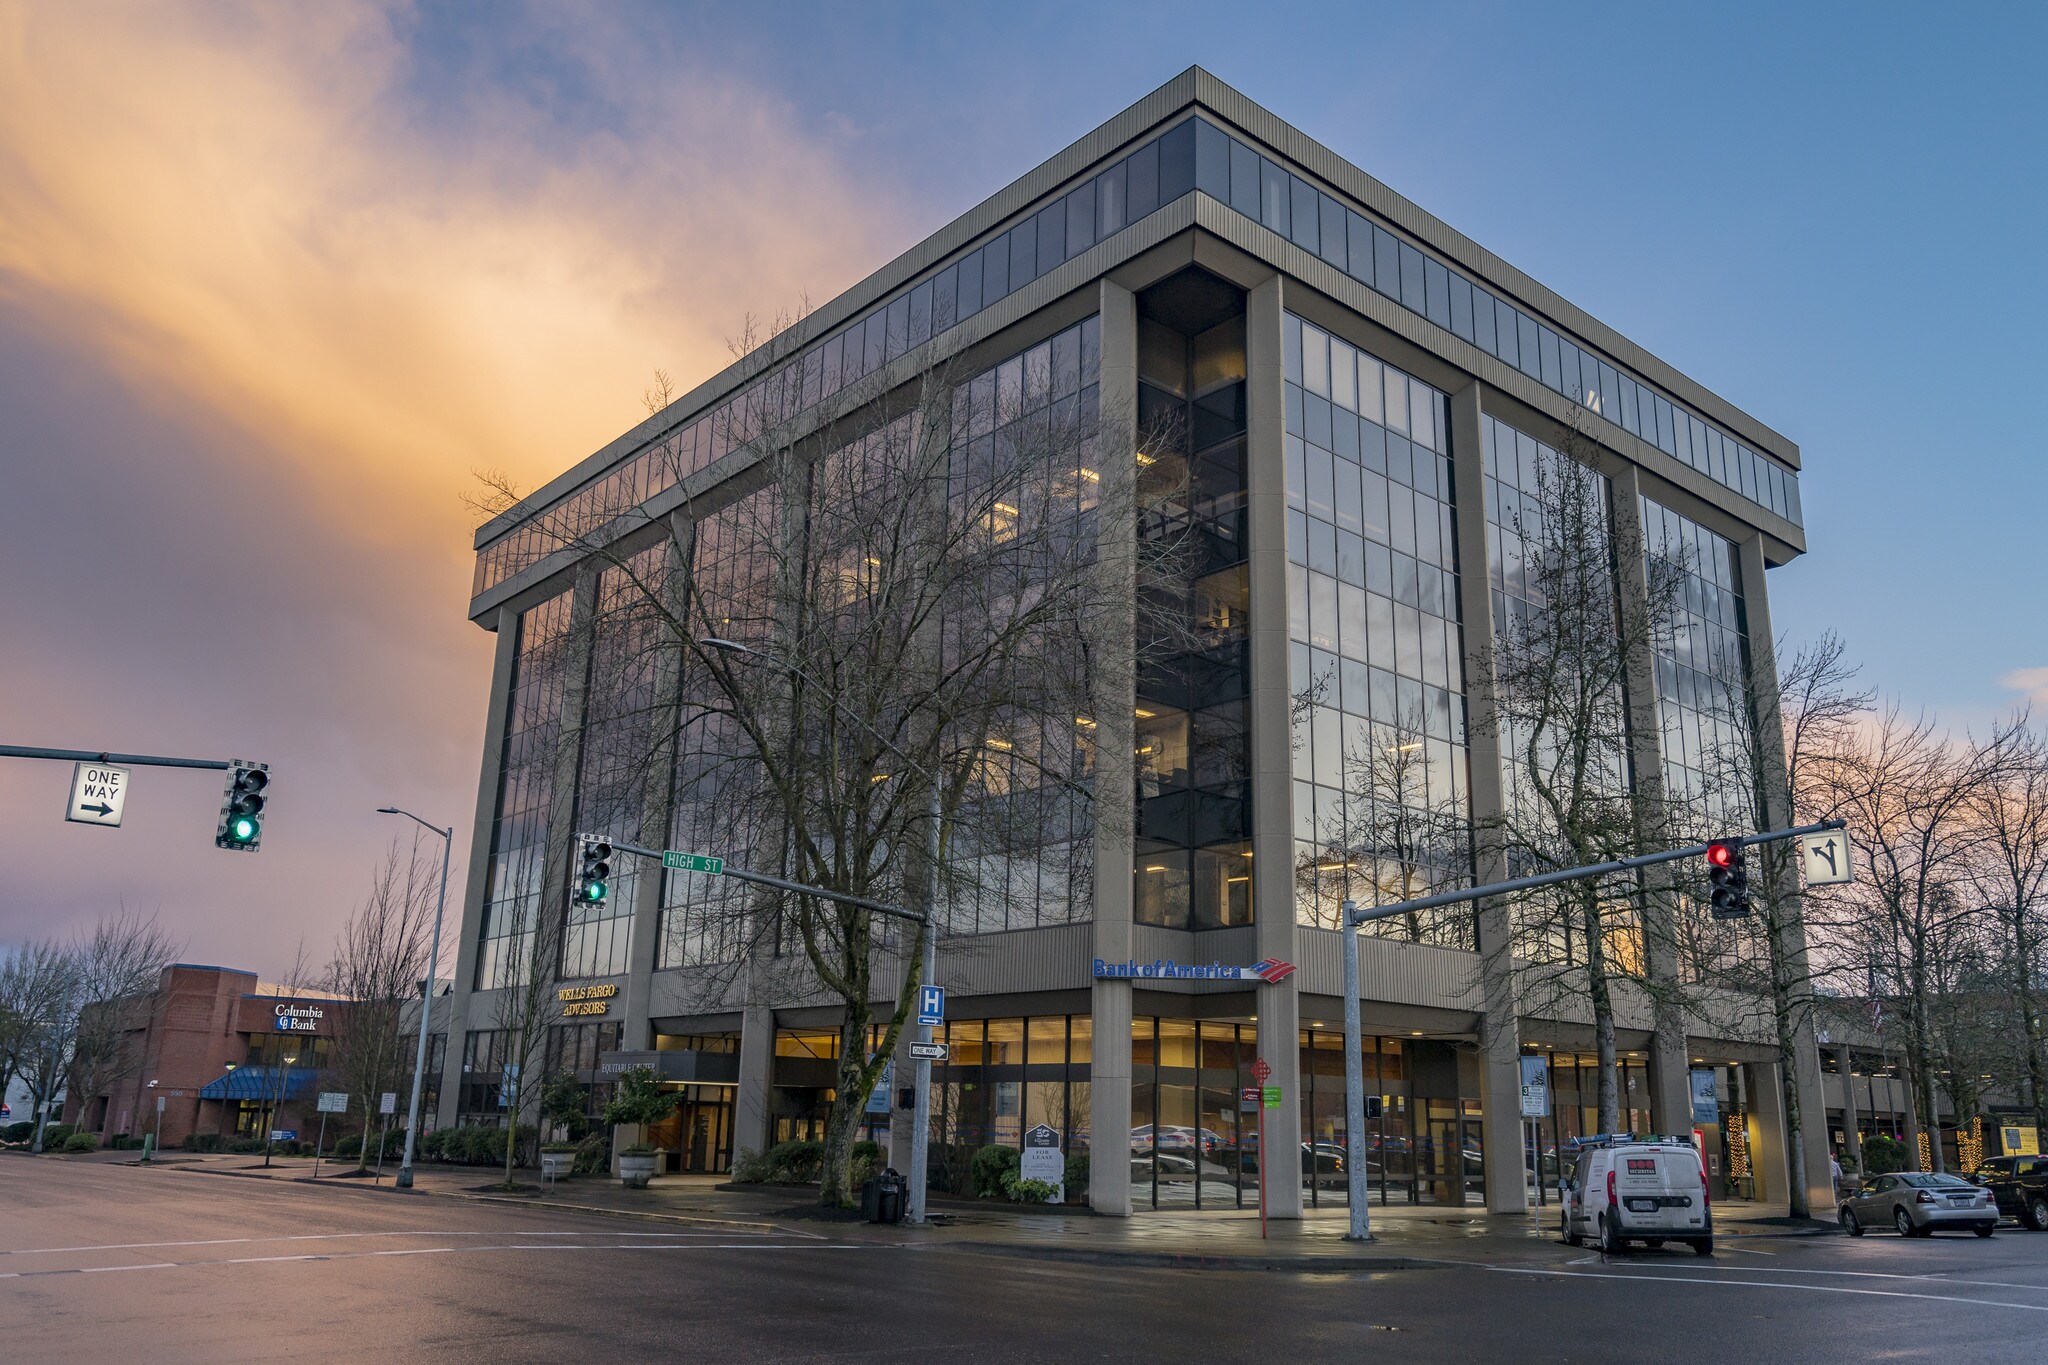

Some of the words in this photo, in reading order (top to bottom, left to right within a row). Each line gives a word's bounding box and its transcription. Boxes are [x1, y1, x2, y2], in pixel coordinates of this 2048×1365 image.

[87, 769, 120, 786] ONE
[84, 783, 119, 800] WAY
[667, 853, 694, 869] HIGH
[704, 858, 718, 872] ST
[1093, 958, 1141, 977] Bank
[1142, 959, 1162, 978] of
[1164, 959, 1242, 979] America
[558, 986, 586, 1001] WELLS
[586, 984, 615, 999] FARGO
[563, 1001, 606, 1016] ADVISORS
[924, 990, 939, 1013] H
[275, 1003, 323, 1018] Columbia
[290, 1017, 317, 1031] Bank
[601, 1063, 631, 1075] EQUITABLE
[1523, 1087, 1528, 1095] 3
